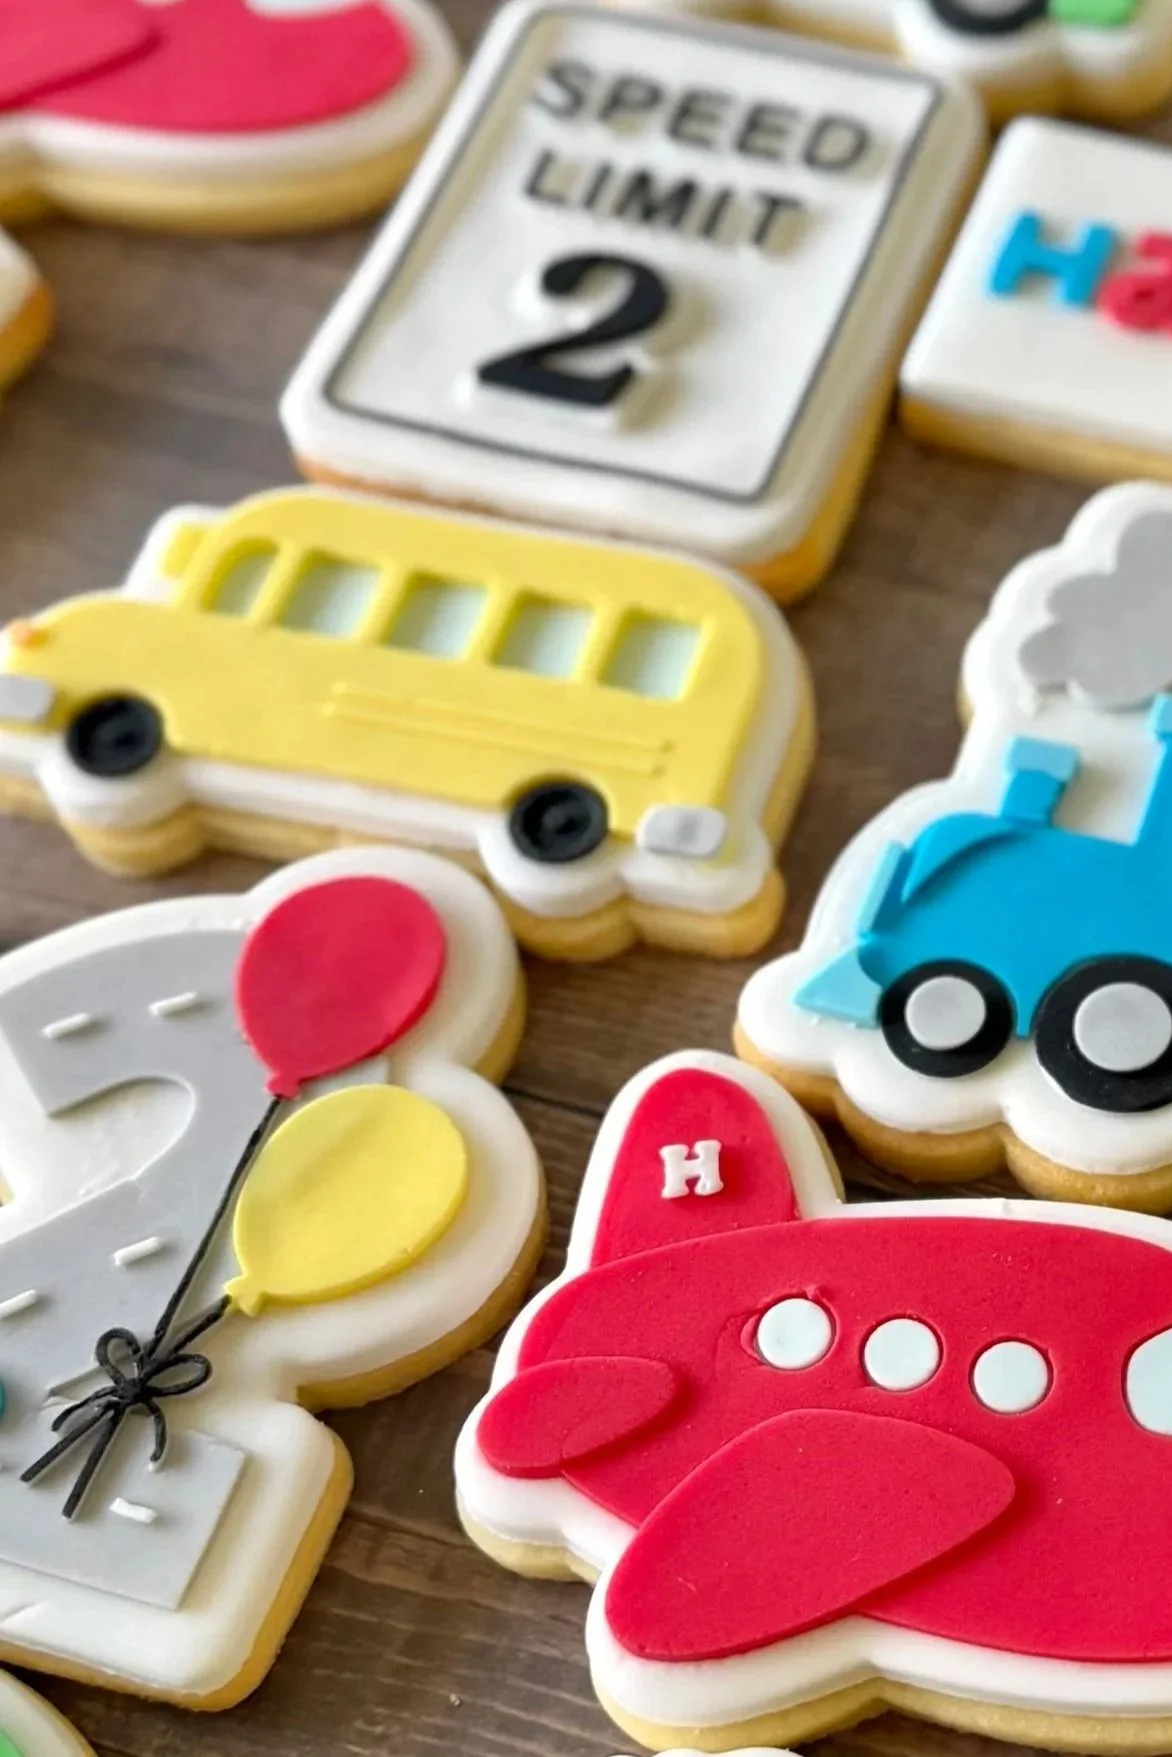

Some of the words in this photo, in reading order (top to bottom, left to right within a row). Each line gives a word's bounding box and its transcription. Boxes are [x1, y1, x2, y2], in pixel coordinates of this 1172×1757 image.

[533, 60, 872, 174] SPEED
[524, 150, 804, 249] LIMIT
[476, 254, 670, 407] 2
[659, 1139, 724, 1199] H
